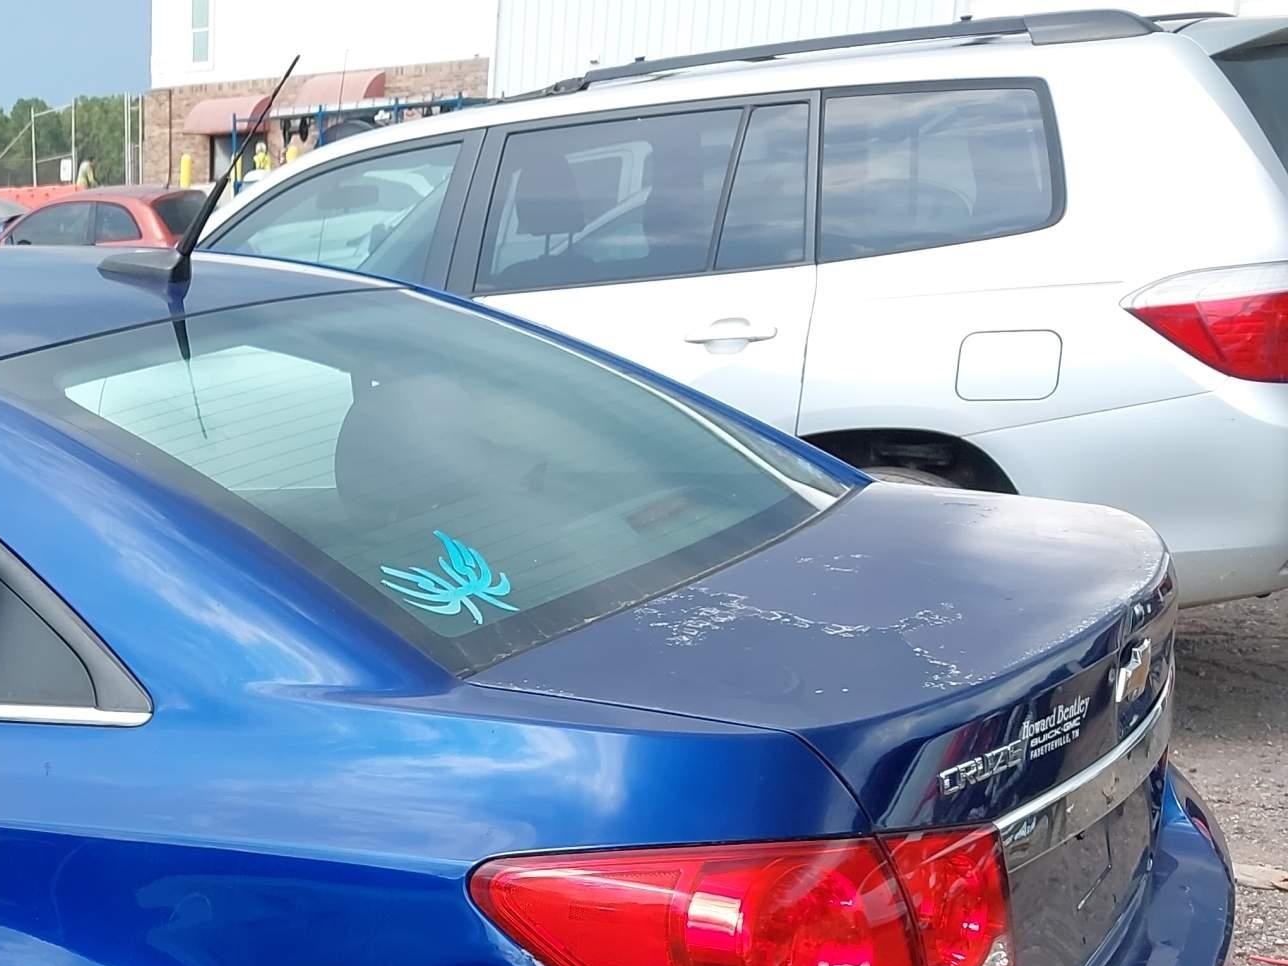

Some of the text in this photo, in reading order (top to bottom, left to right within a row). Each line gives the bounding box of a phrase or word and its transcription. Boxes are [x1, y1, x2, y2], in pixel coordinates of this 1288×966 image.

[1022, 694, 1091, 740] Howard Bentley
[936, 739, 1023, 796] CRUZE
